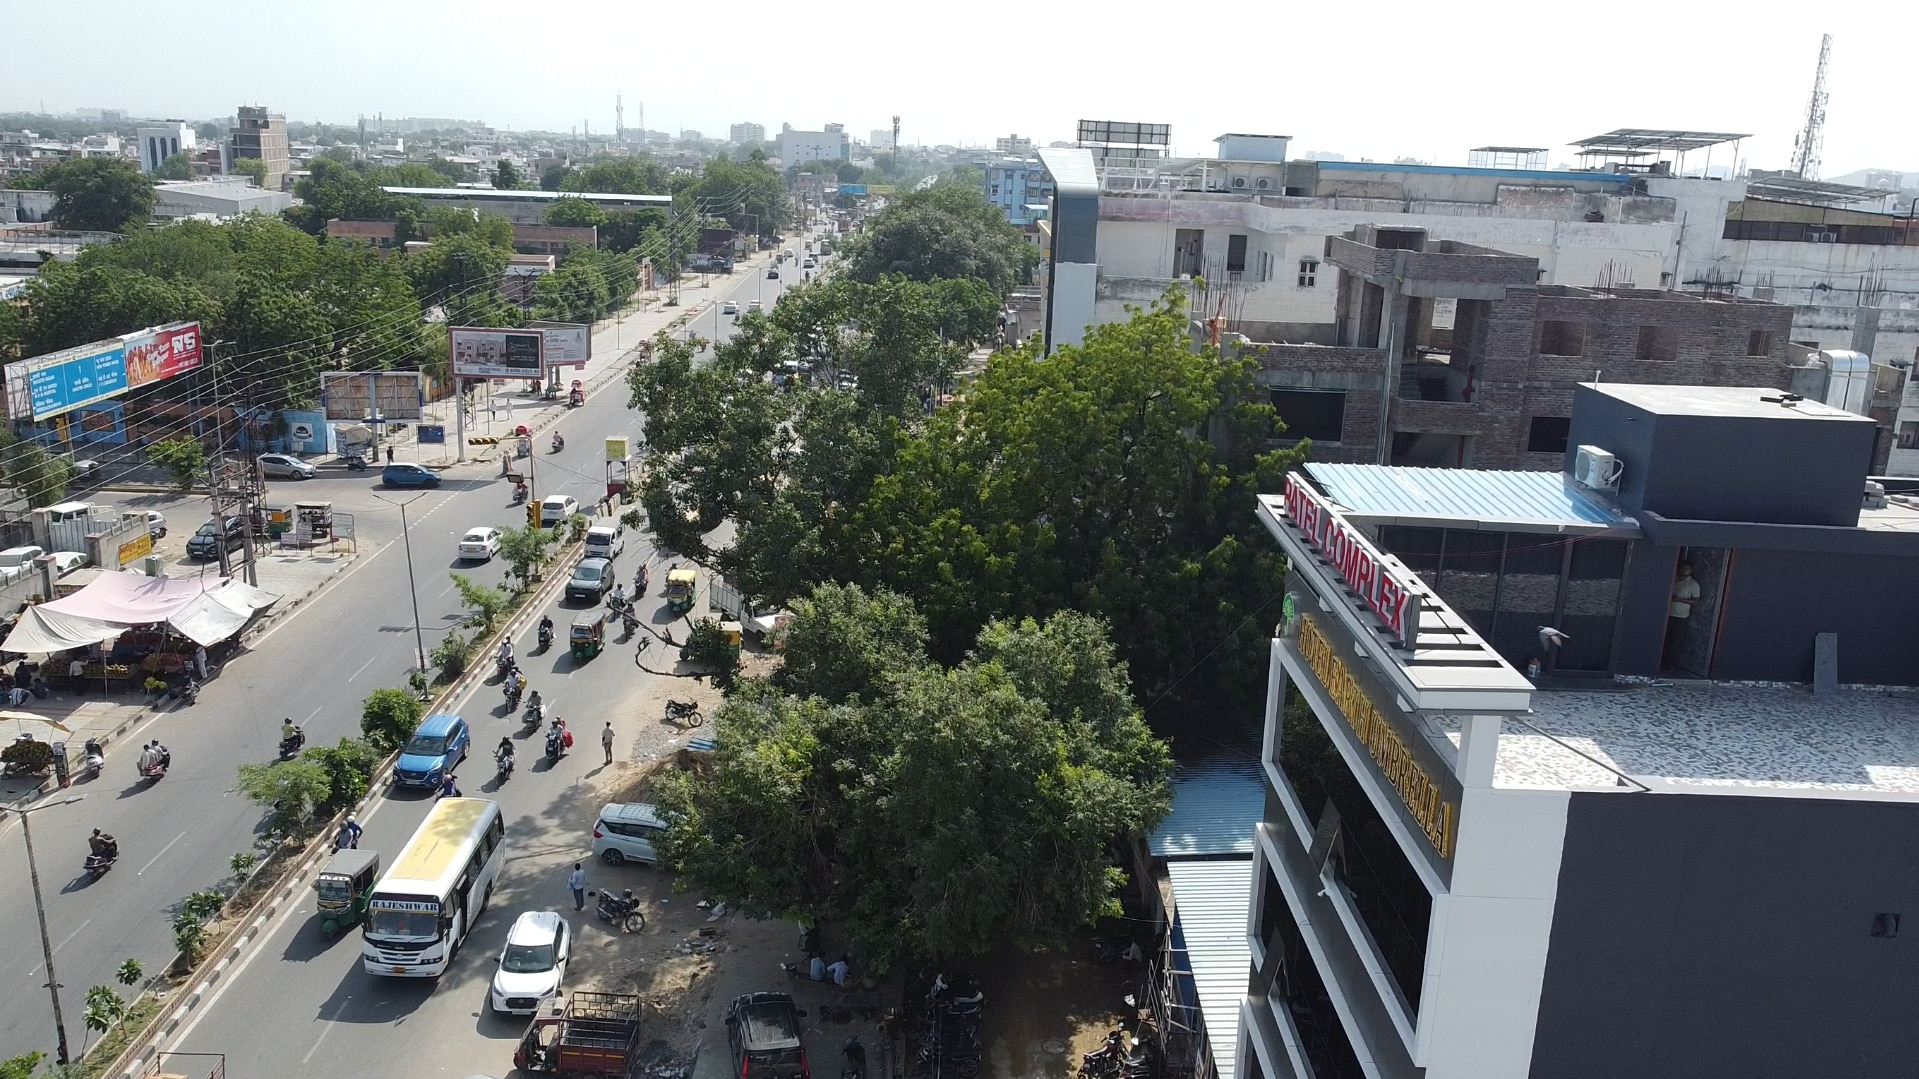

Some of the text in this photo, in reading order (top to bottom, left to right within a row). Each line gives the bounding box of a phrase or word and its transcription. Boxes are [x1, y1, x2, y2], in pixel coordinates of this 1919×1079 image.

[1284, 475, 1410, 639] PATEL COMPLEX
[1369, 709, 1451, 858] UMBRELLA
[372, 901, 438, 911] RAJESHWAR
